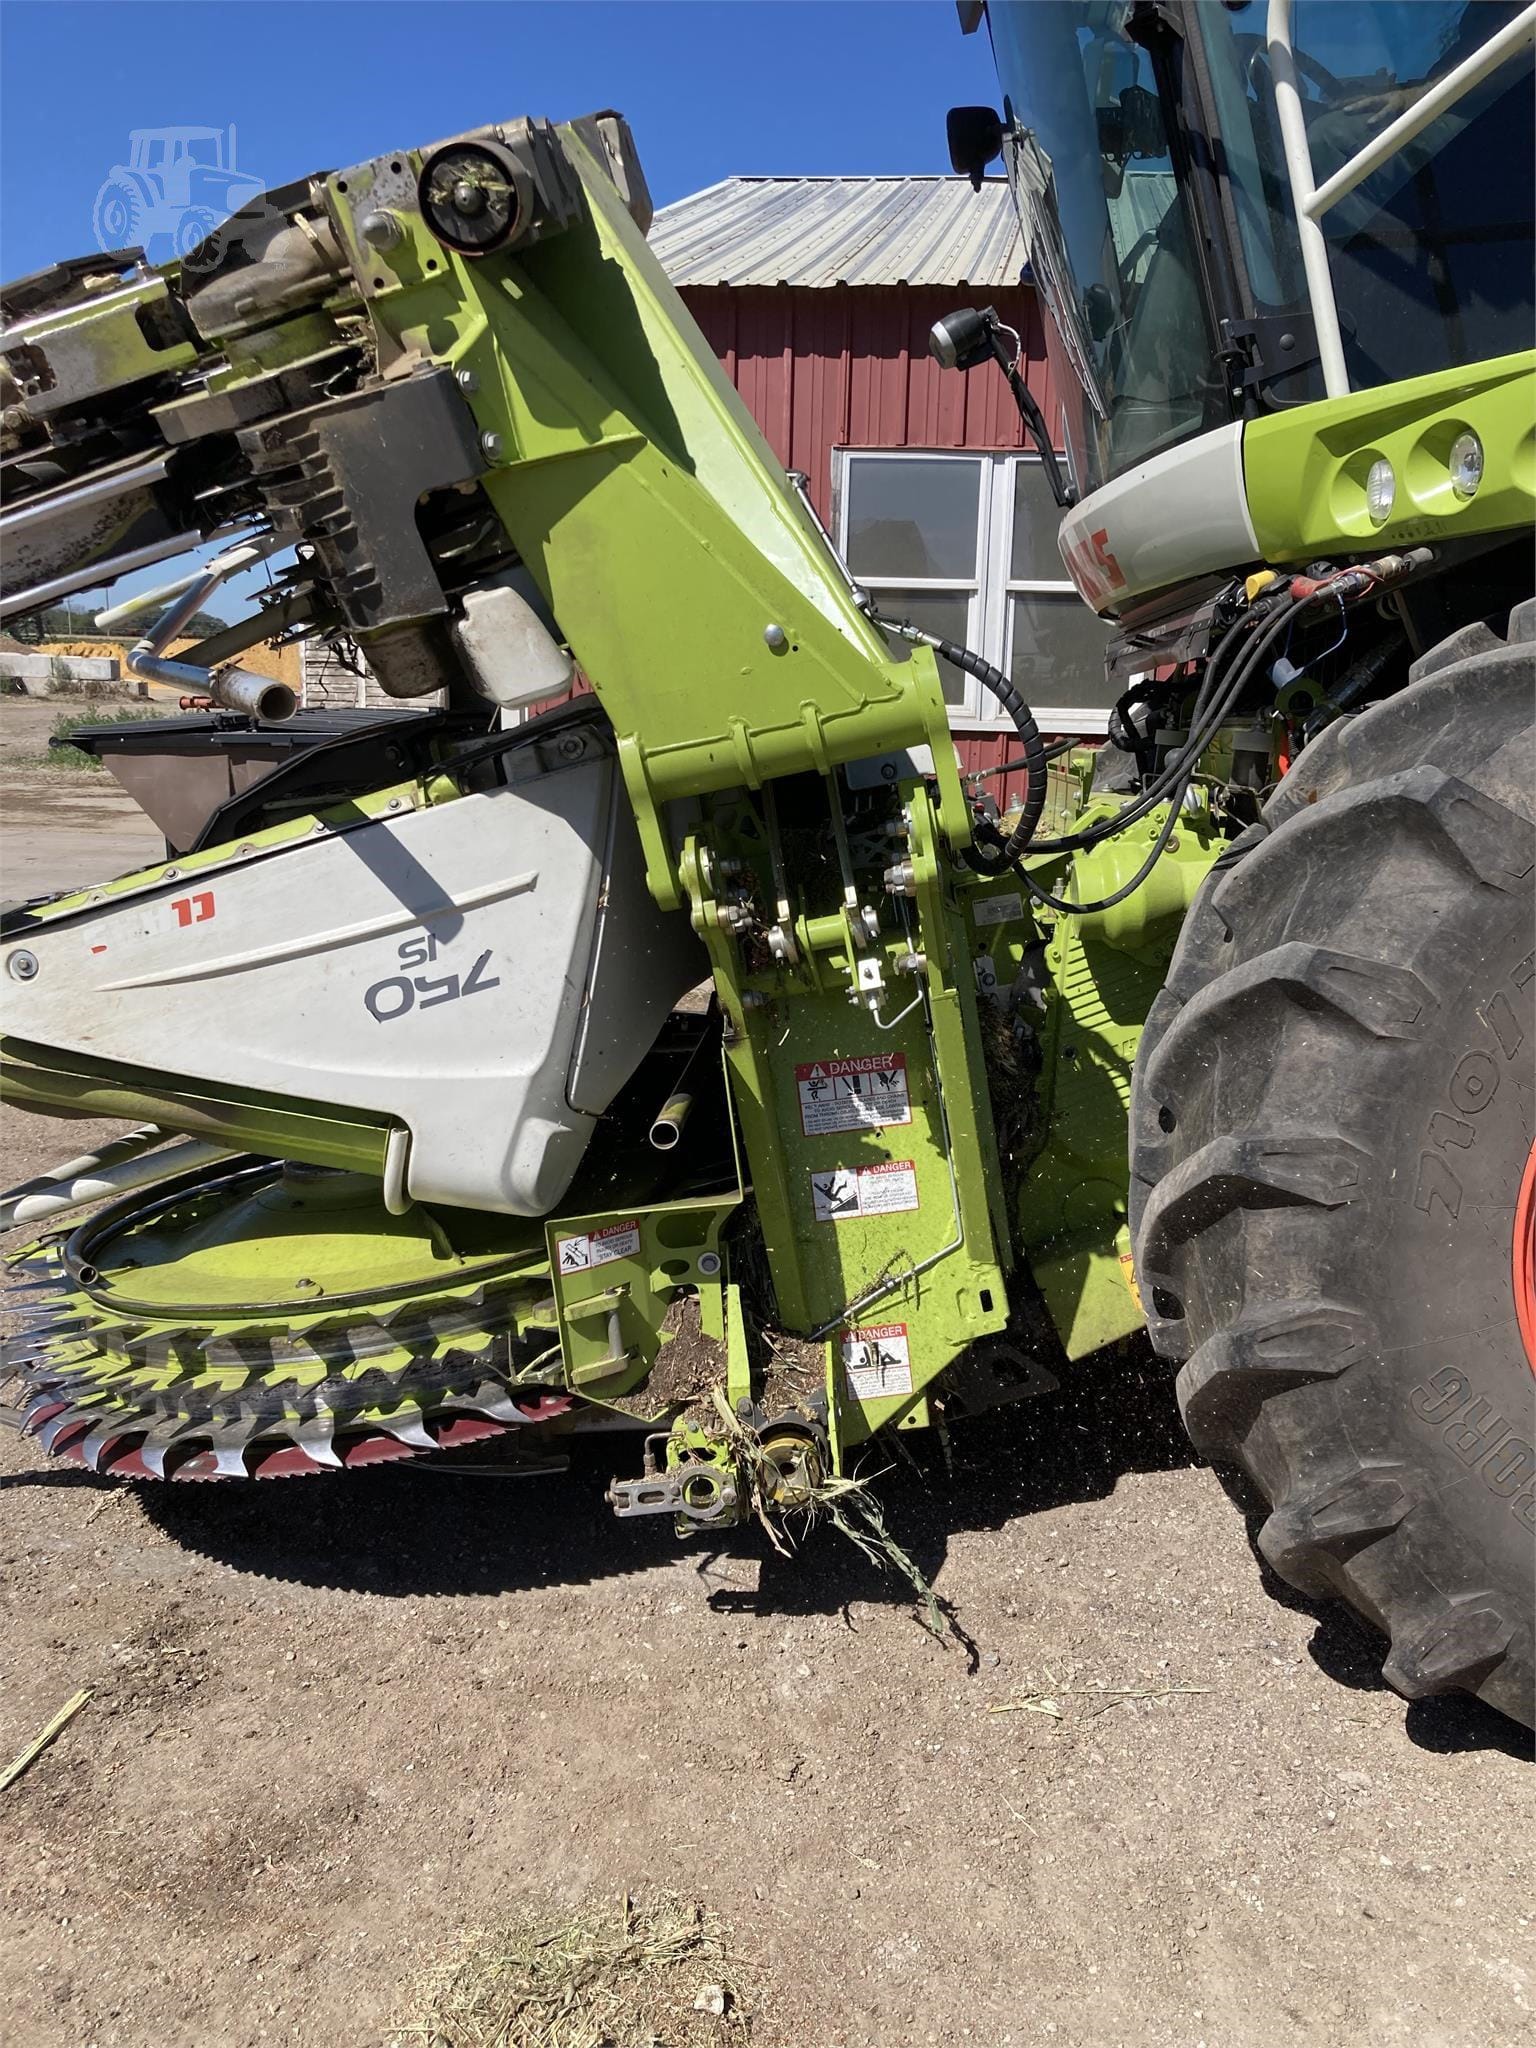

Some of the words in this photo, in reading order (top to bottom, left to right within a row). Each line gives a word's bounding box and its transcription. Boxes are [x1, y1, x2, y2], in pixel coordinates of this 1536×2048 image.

[398, 933, 437, 971] IS
[364, 949, 500, 1024] 750
[829, 1056, 893, 1075] DANGER
[873, 1161, 911, 1173] DANGER
[602, 1221, 636, 1237] DANGER
[857, 1325, 903, 1340] DANGER
